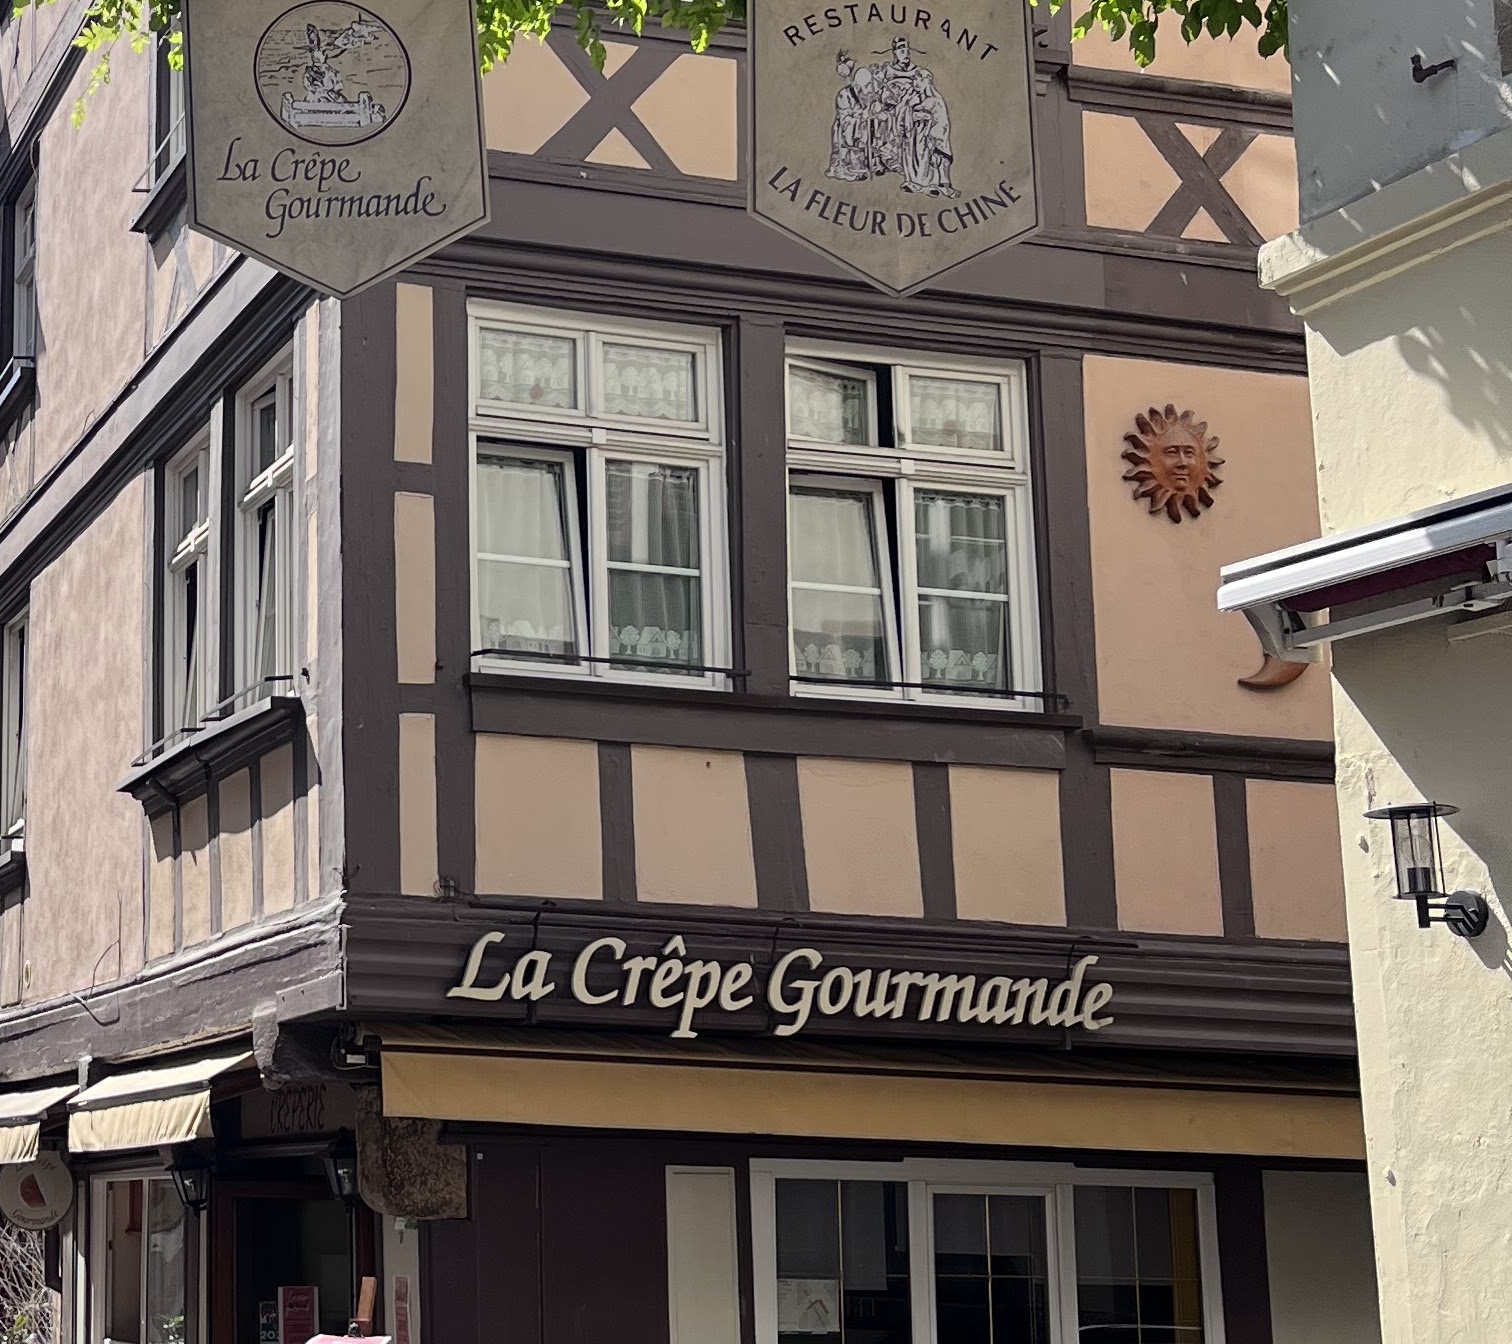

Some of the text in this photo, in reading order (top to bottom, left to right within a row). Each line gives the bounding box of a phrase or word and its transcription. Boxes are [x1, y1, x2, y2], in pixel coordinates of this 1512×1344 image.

[782, 2, 999, 62] RESTAURANT
[217, 136, 361, 193] La Crêpe
[265, 175, 447, 239] Gourmande
[767, 165, 1022, 238] LA FLEUR DE CHINE
[447, 930, 1115, 1039] La Crêpe Gourmande
